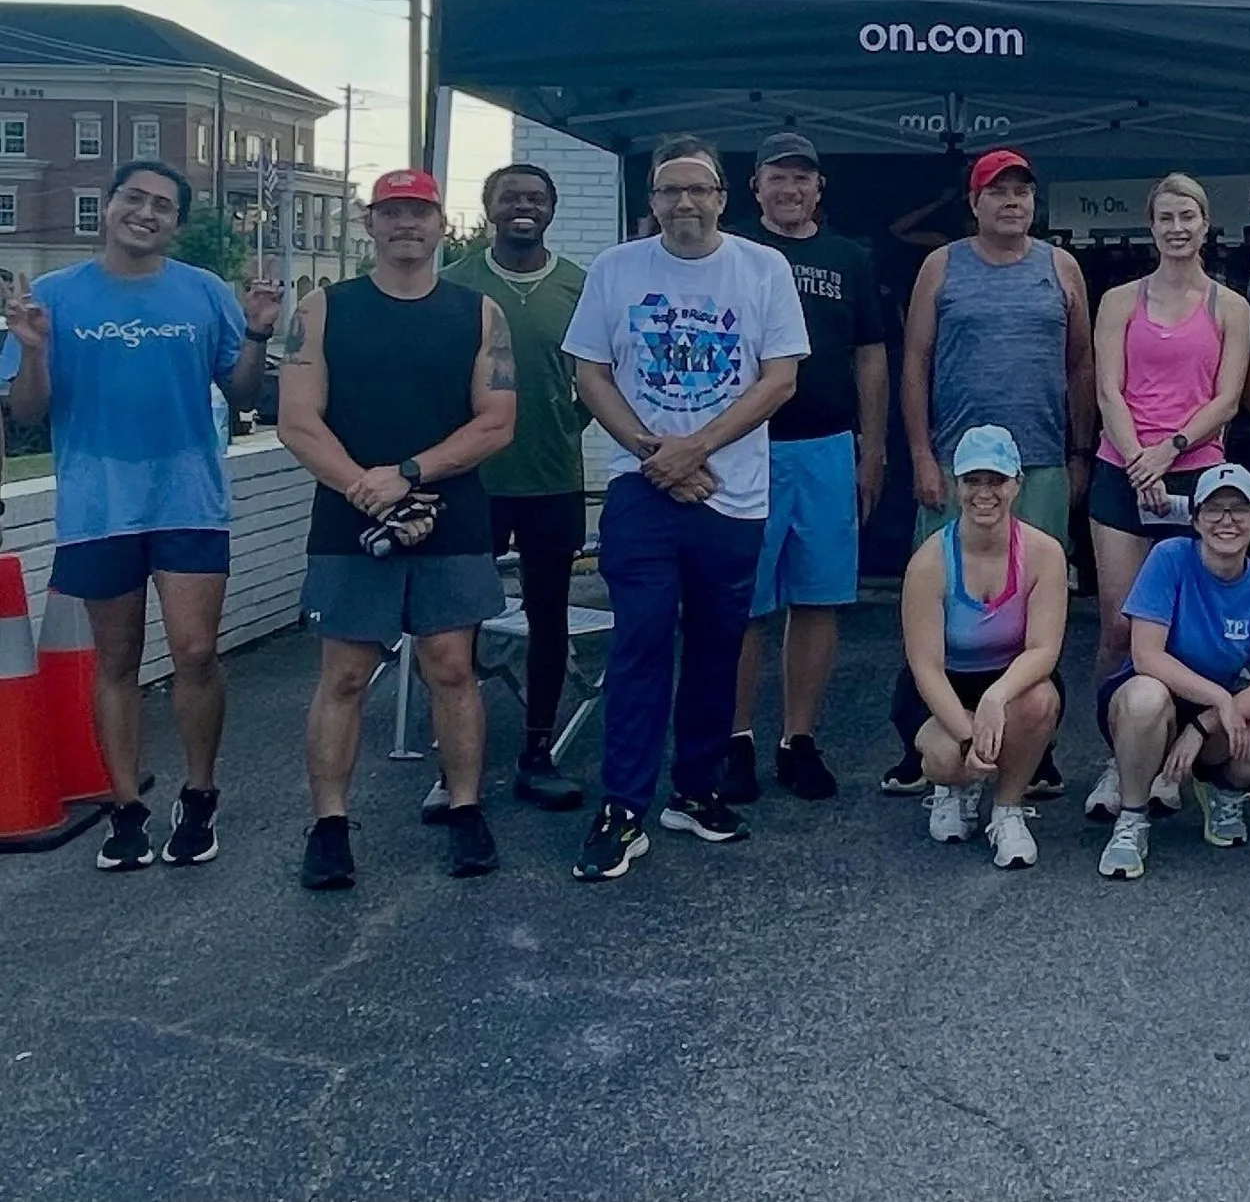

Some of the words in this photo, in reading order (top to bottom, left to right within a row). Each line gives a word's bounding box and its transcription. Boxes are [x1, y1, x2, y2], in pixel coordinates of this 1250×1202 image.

[859, 23, 1023, 56] on.com
[1079, 196, 1100, 216] Try
[797, 277, 842, 299] ITLESS
